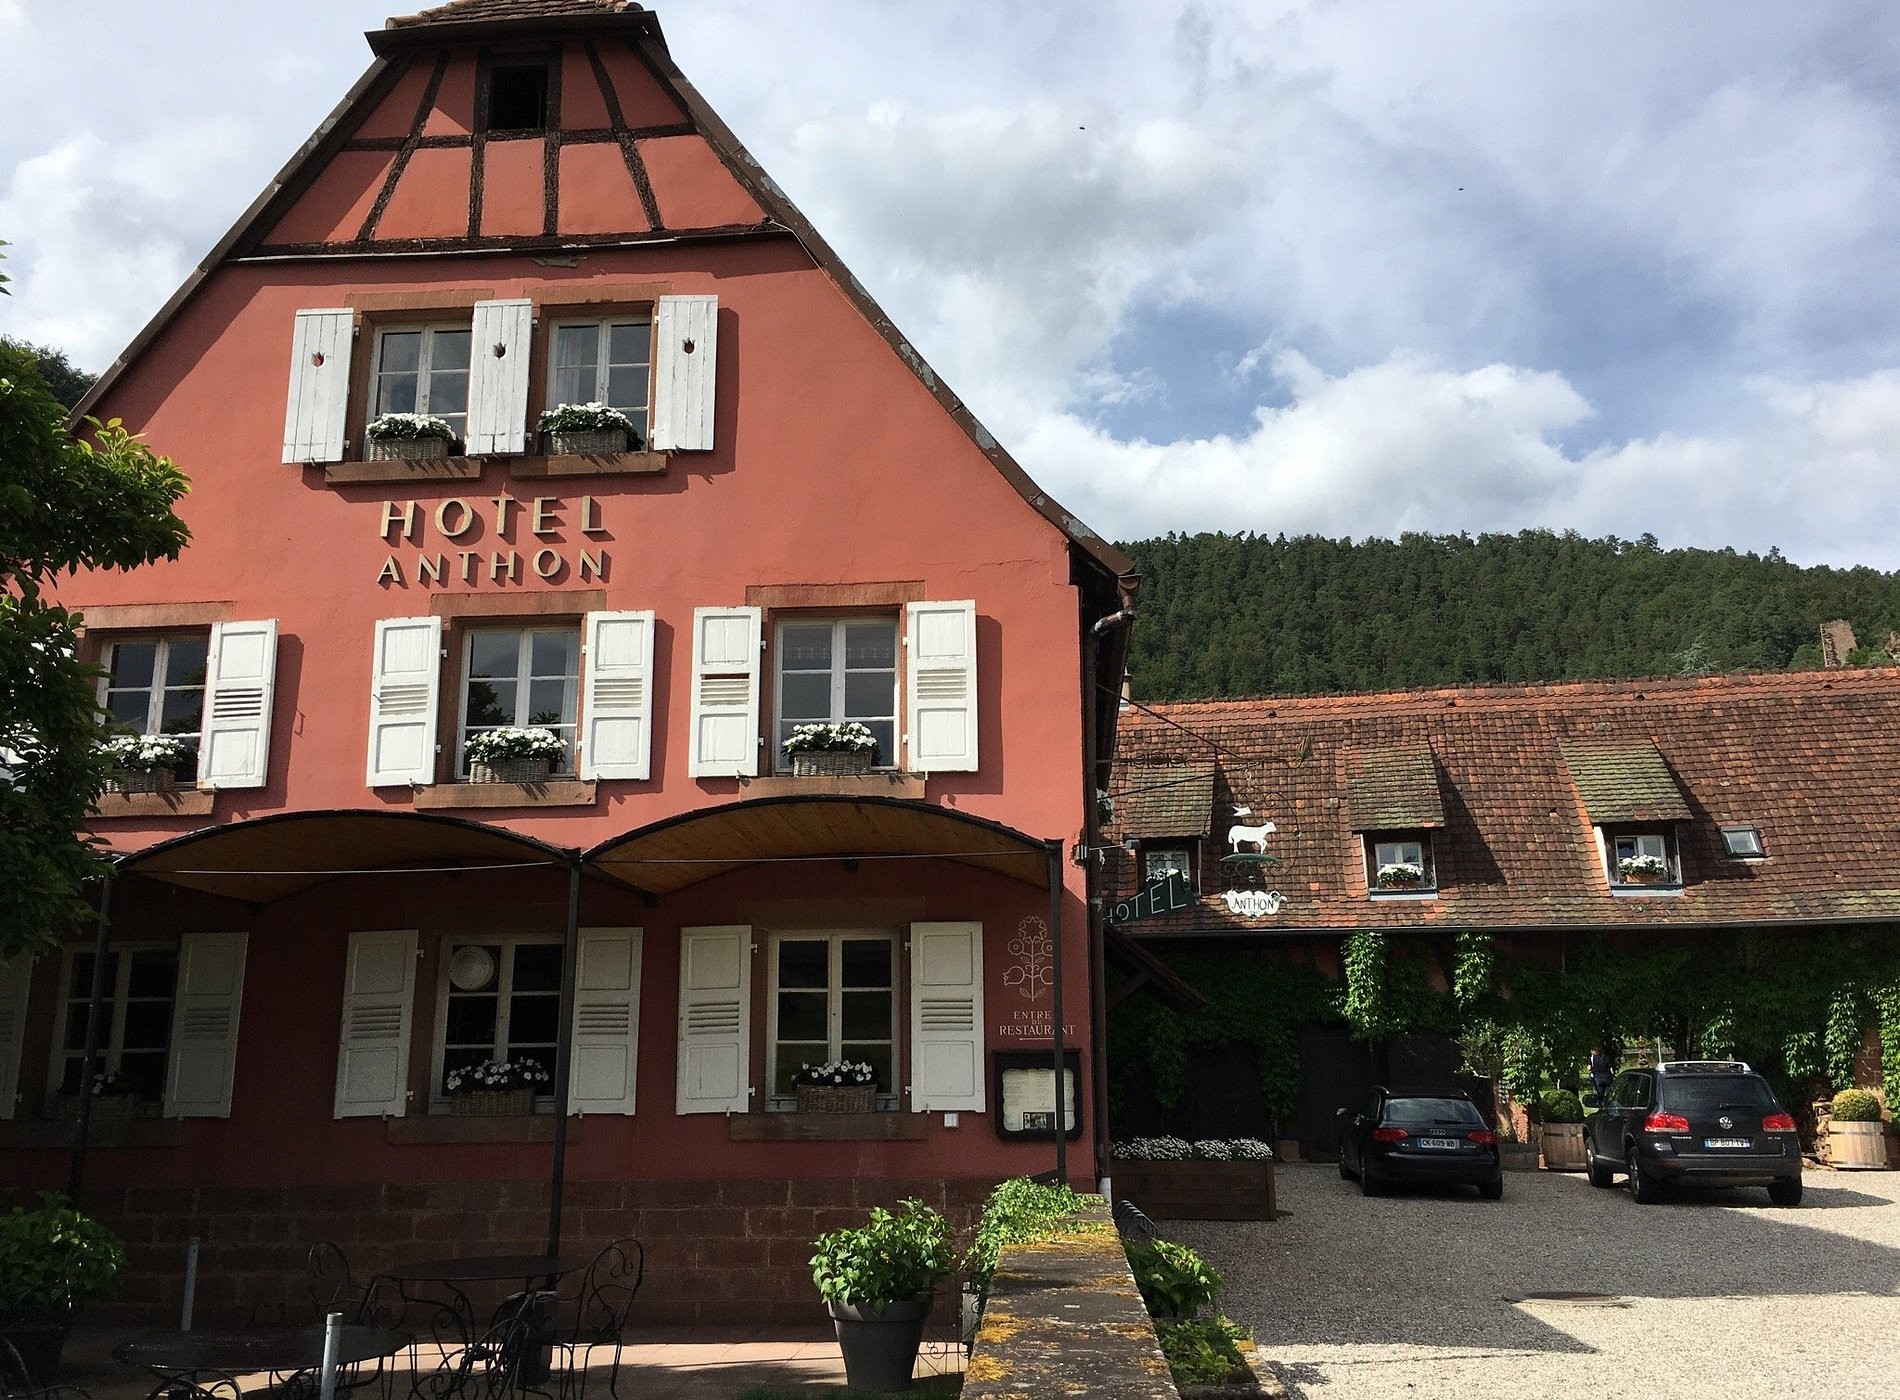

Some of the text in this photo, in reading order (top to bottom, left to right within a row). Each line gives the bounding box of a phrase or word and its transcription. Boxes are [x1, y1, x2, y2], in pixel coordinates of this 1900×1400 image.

[380, 495, 605, 538] HOTEL
[377, 548, 603, 583] ANTHON
[1231, 897, 1275, 911] ANTHON
[999, 1024, 1076, 1036] RESTAURNT
